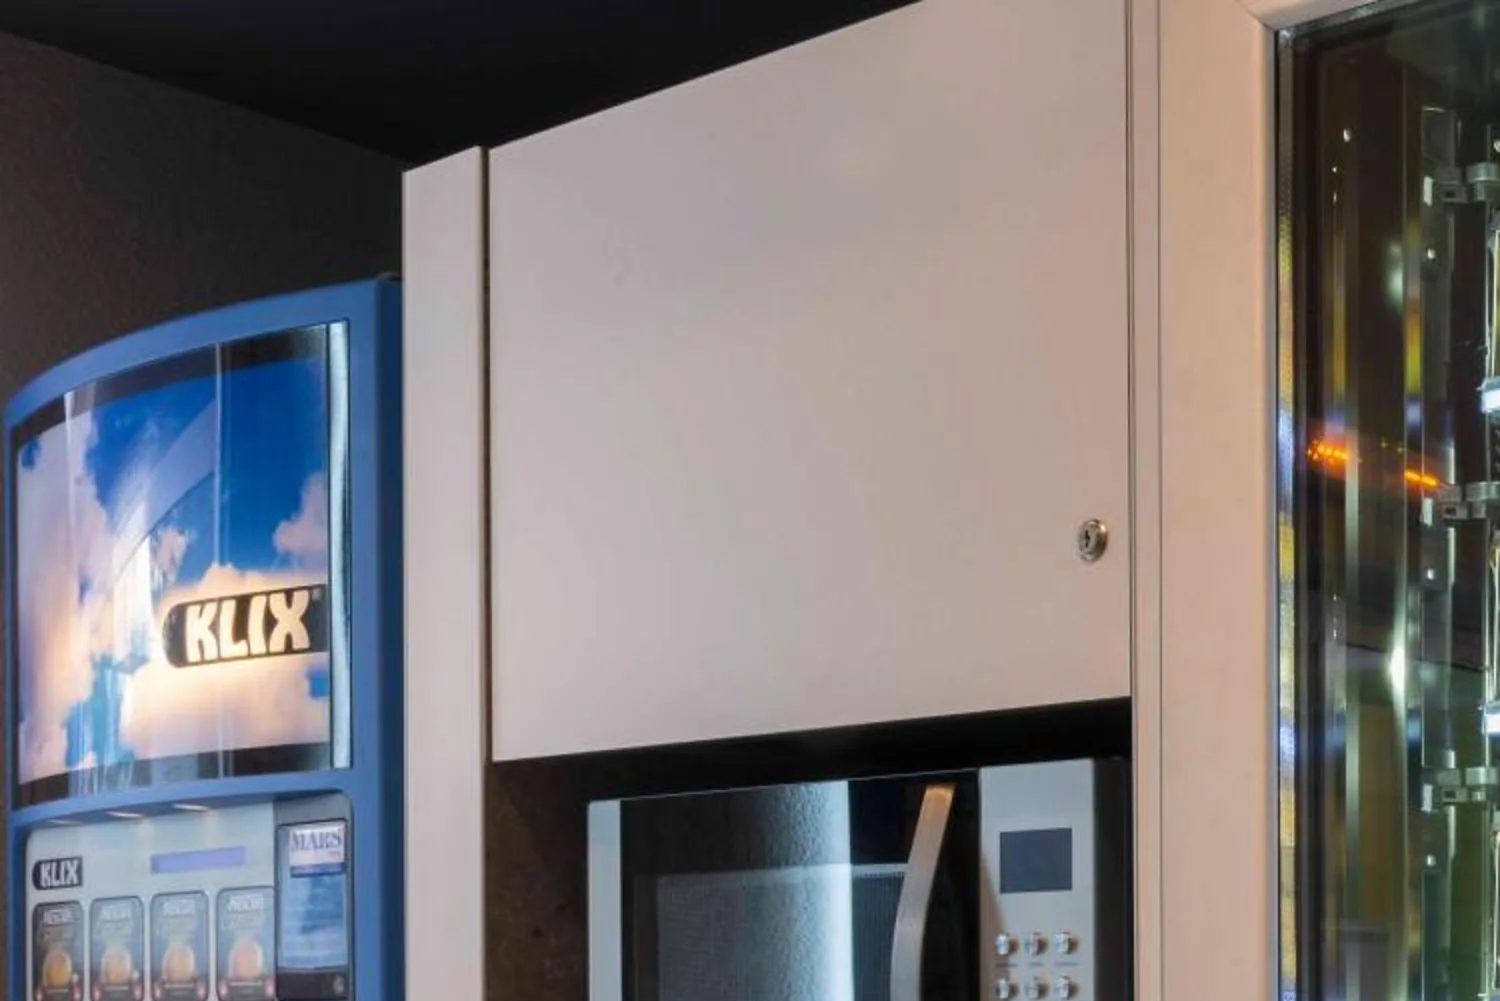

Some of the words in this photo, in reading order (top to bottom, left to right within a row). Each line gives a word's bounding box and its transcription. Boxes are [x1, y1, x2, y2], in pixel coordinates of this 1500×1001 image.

[184, 588, 311, 664] KLIX
[291, 830, 342, 851] MARS
[39, 858, 79, 888] KLIX
